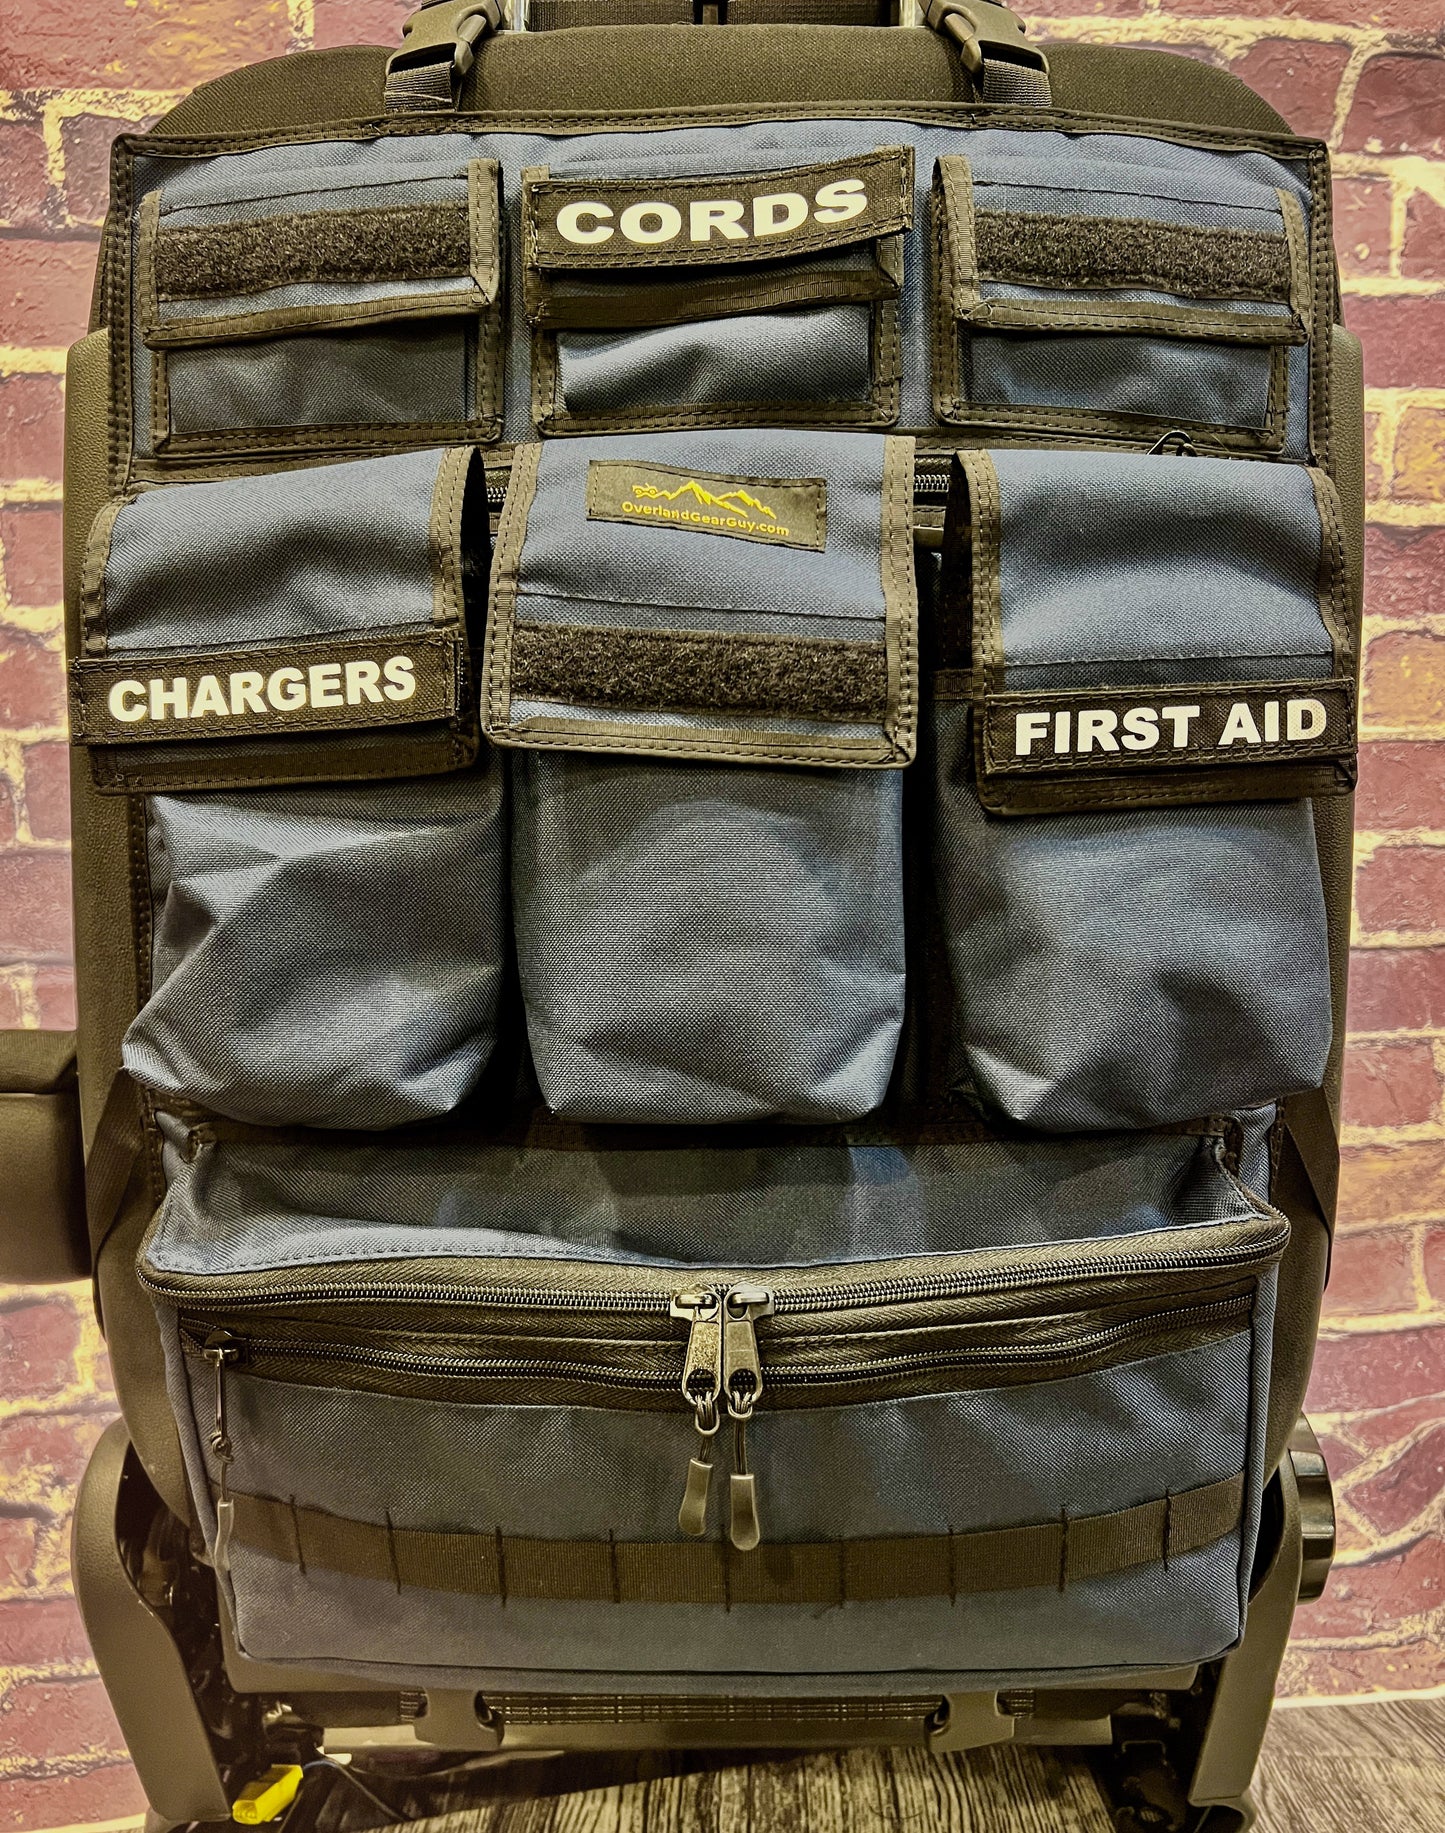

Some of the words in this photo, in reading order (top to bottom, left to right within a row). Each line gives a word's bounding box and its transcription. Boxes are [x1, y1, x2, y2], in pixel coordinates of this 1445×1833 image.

[556, 179, 868, 245] CORDS
[621, 501, 790, 536] OverlandGearGuy.com
[108, 655, 416, 722] CHARGERS
[1015, 705, 1200, 756] FIRST
[1218, 699, 1327, 745] AID
